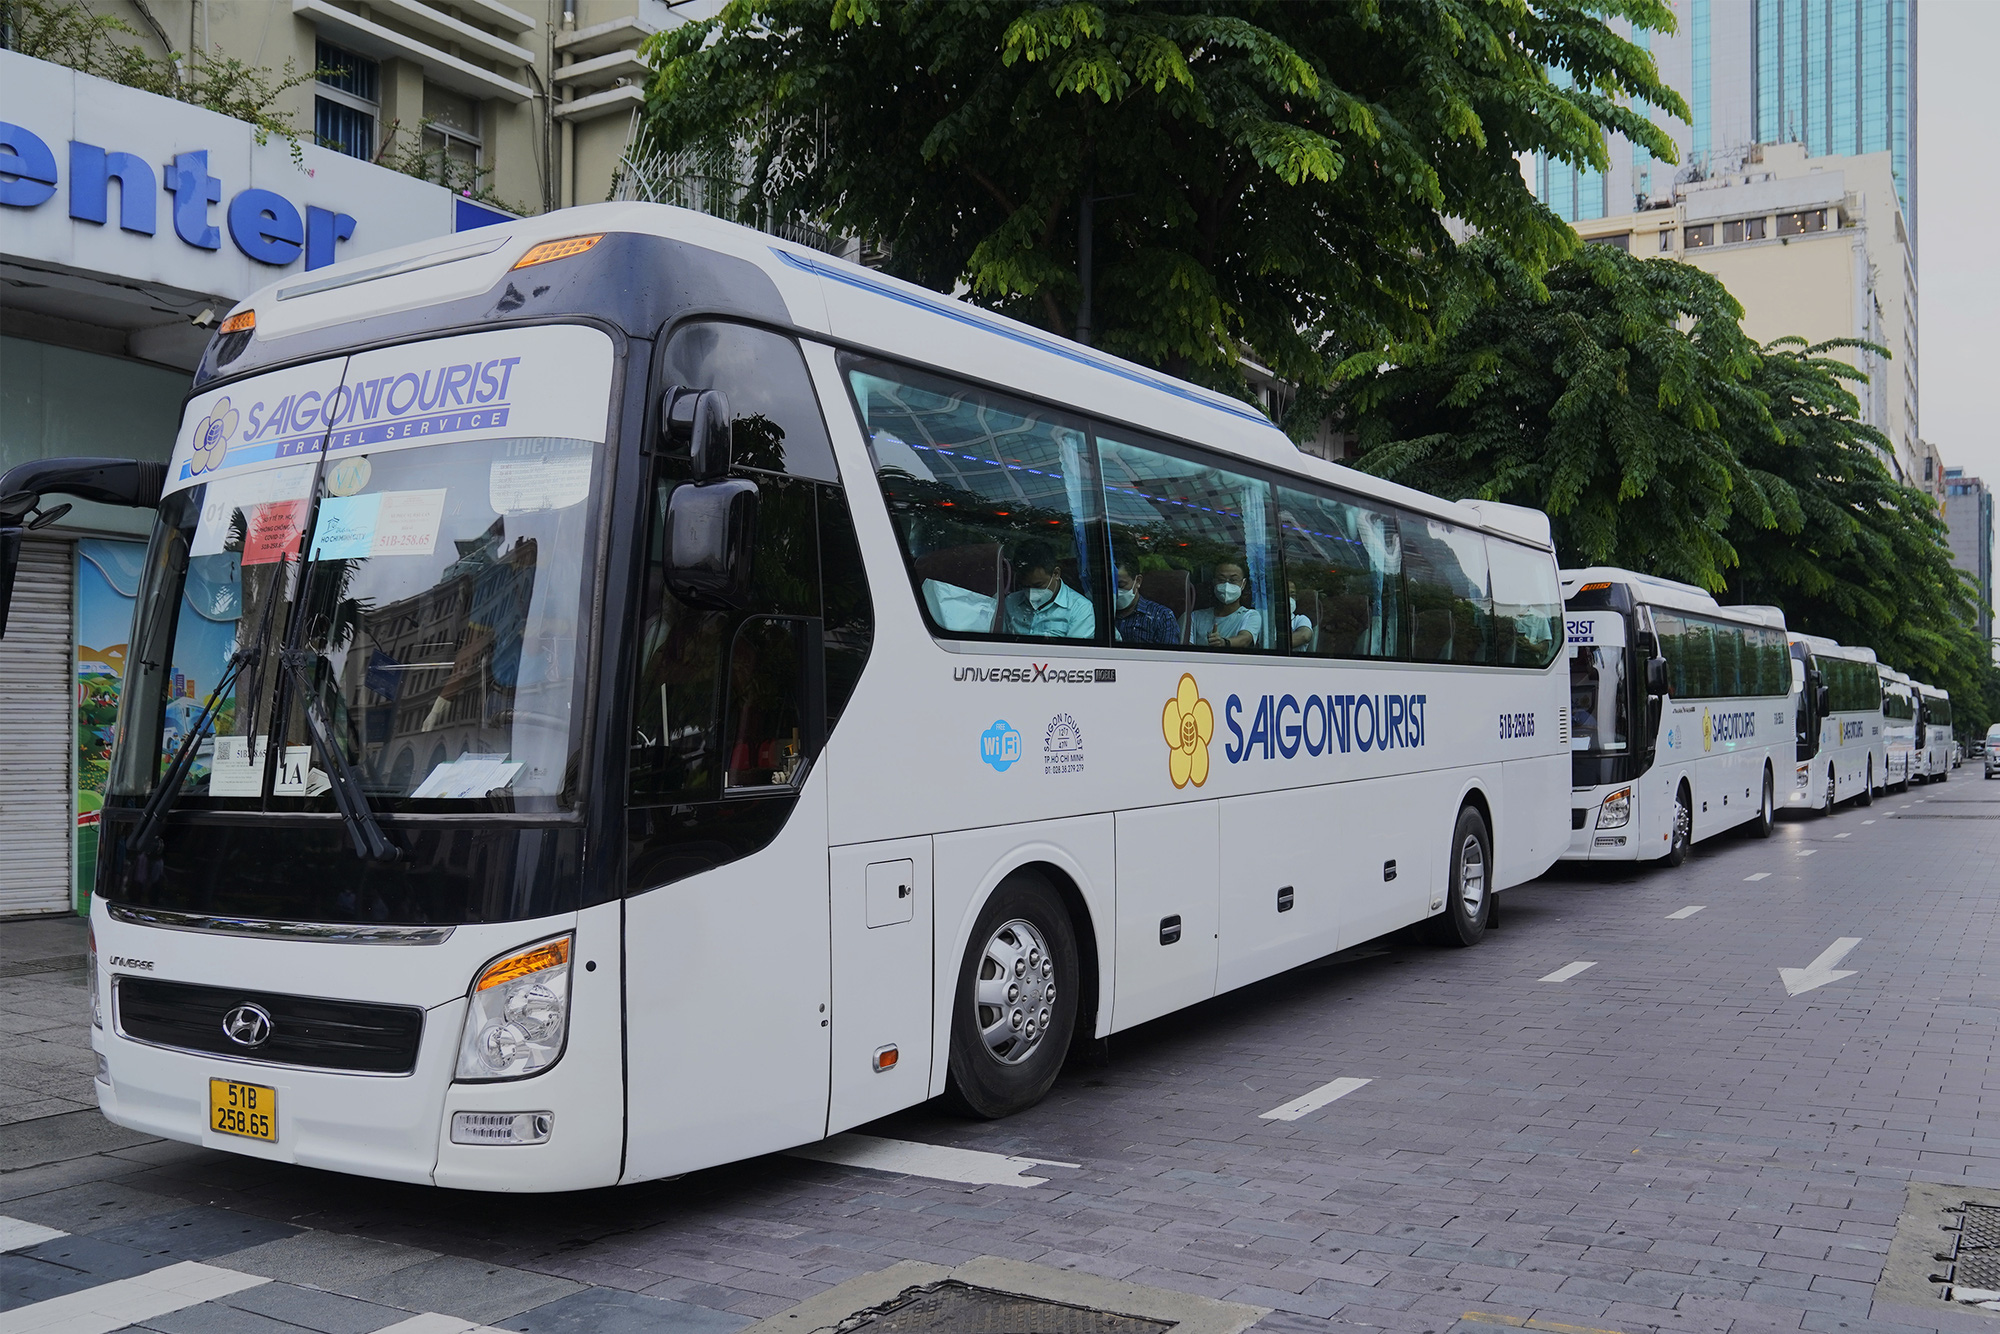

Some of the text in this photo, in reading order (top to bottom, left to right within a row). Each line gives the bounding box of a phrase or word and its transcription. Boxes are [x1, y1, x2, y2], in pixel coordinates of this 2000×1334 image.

[243, 357, 521, 442] SAIGONTOURIST
[282, 412, 502, 455] TRAVEL SERVICE
[336, 463, 367, 490] VN
[380, 534, 430, 547] 51B-258.65
[1044, 713, 1083, 752] SAIGON TOURIST
[1225, 693, 1427, 764] SAIGONTOURIST
[1500, 712, 1535, 739] 51B-258.65
[280, 762, 303, 785] 1A
[109, 955, 155, 971] UNIVERSE
[228, 1084, 257, 1110] 51B
[217, 1107, 269, 1137] 258.65
